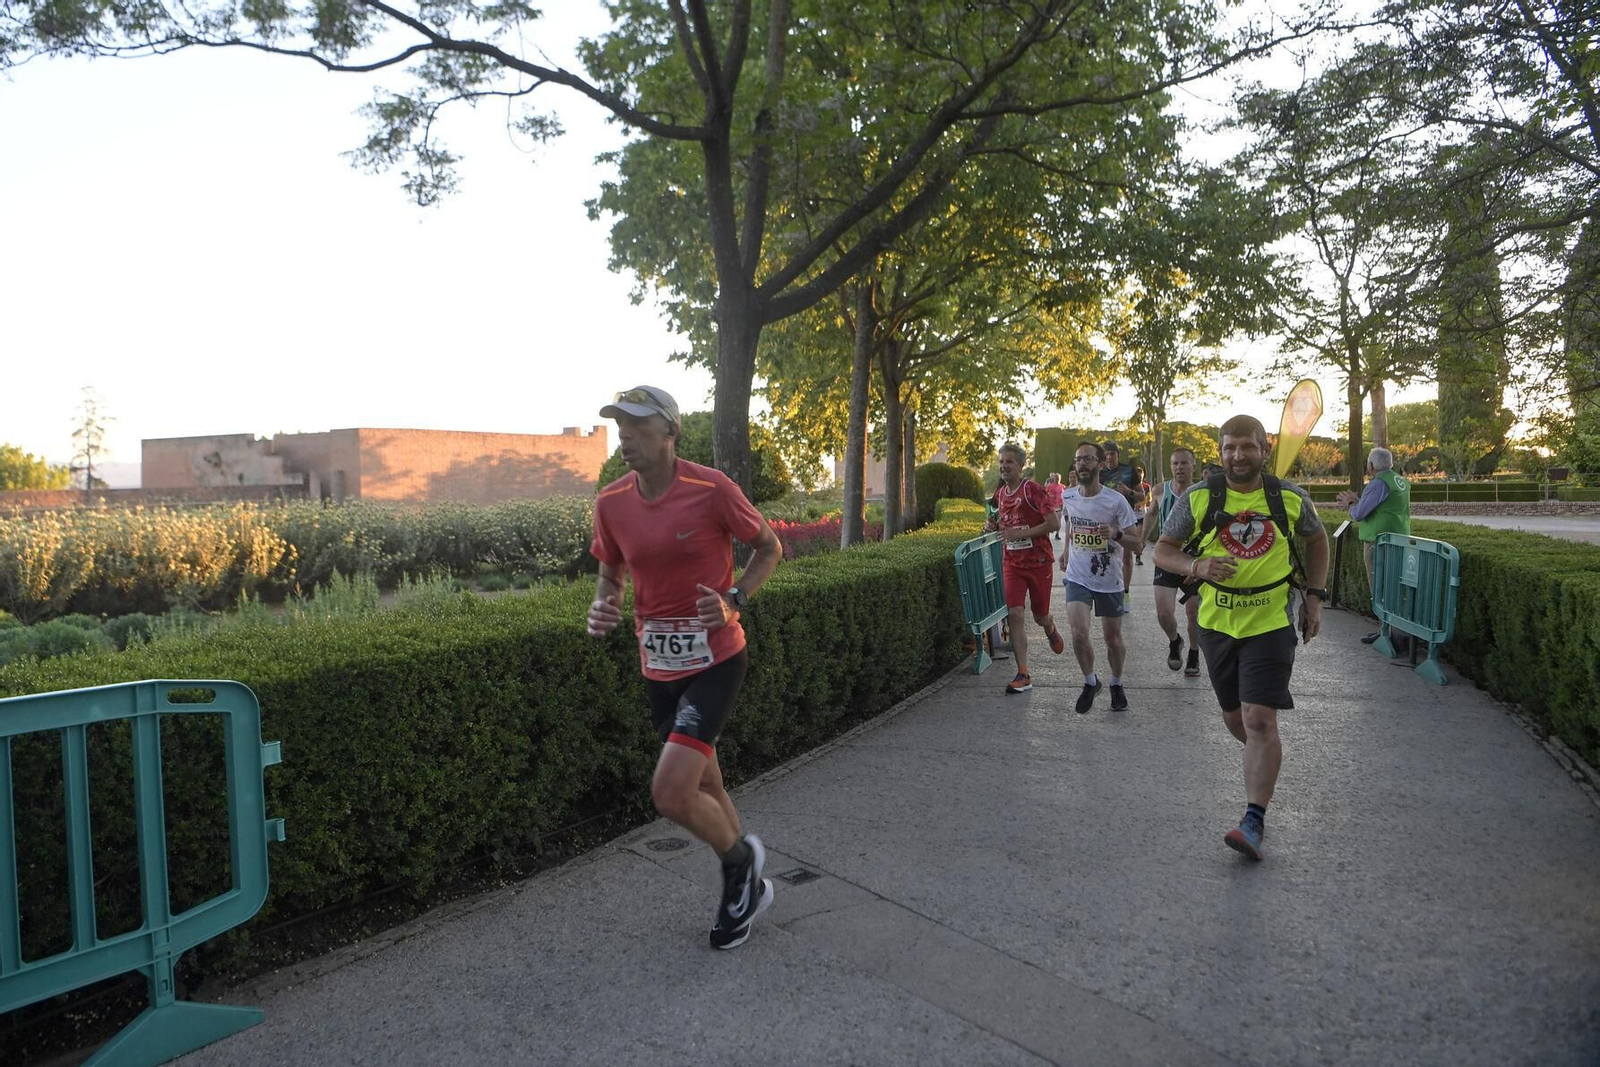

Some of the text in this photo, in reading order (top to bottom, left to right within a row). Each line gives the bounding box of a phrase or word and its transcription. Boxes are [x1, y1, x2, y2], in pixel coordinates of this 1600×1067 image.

[1075, 534, 1102, 545] 5306
[1240, 532, 1273, 557] PROTECTION
[1235, 598, 1270, 608] ABADES
[645, 634, 696, 655] 4767
